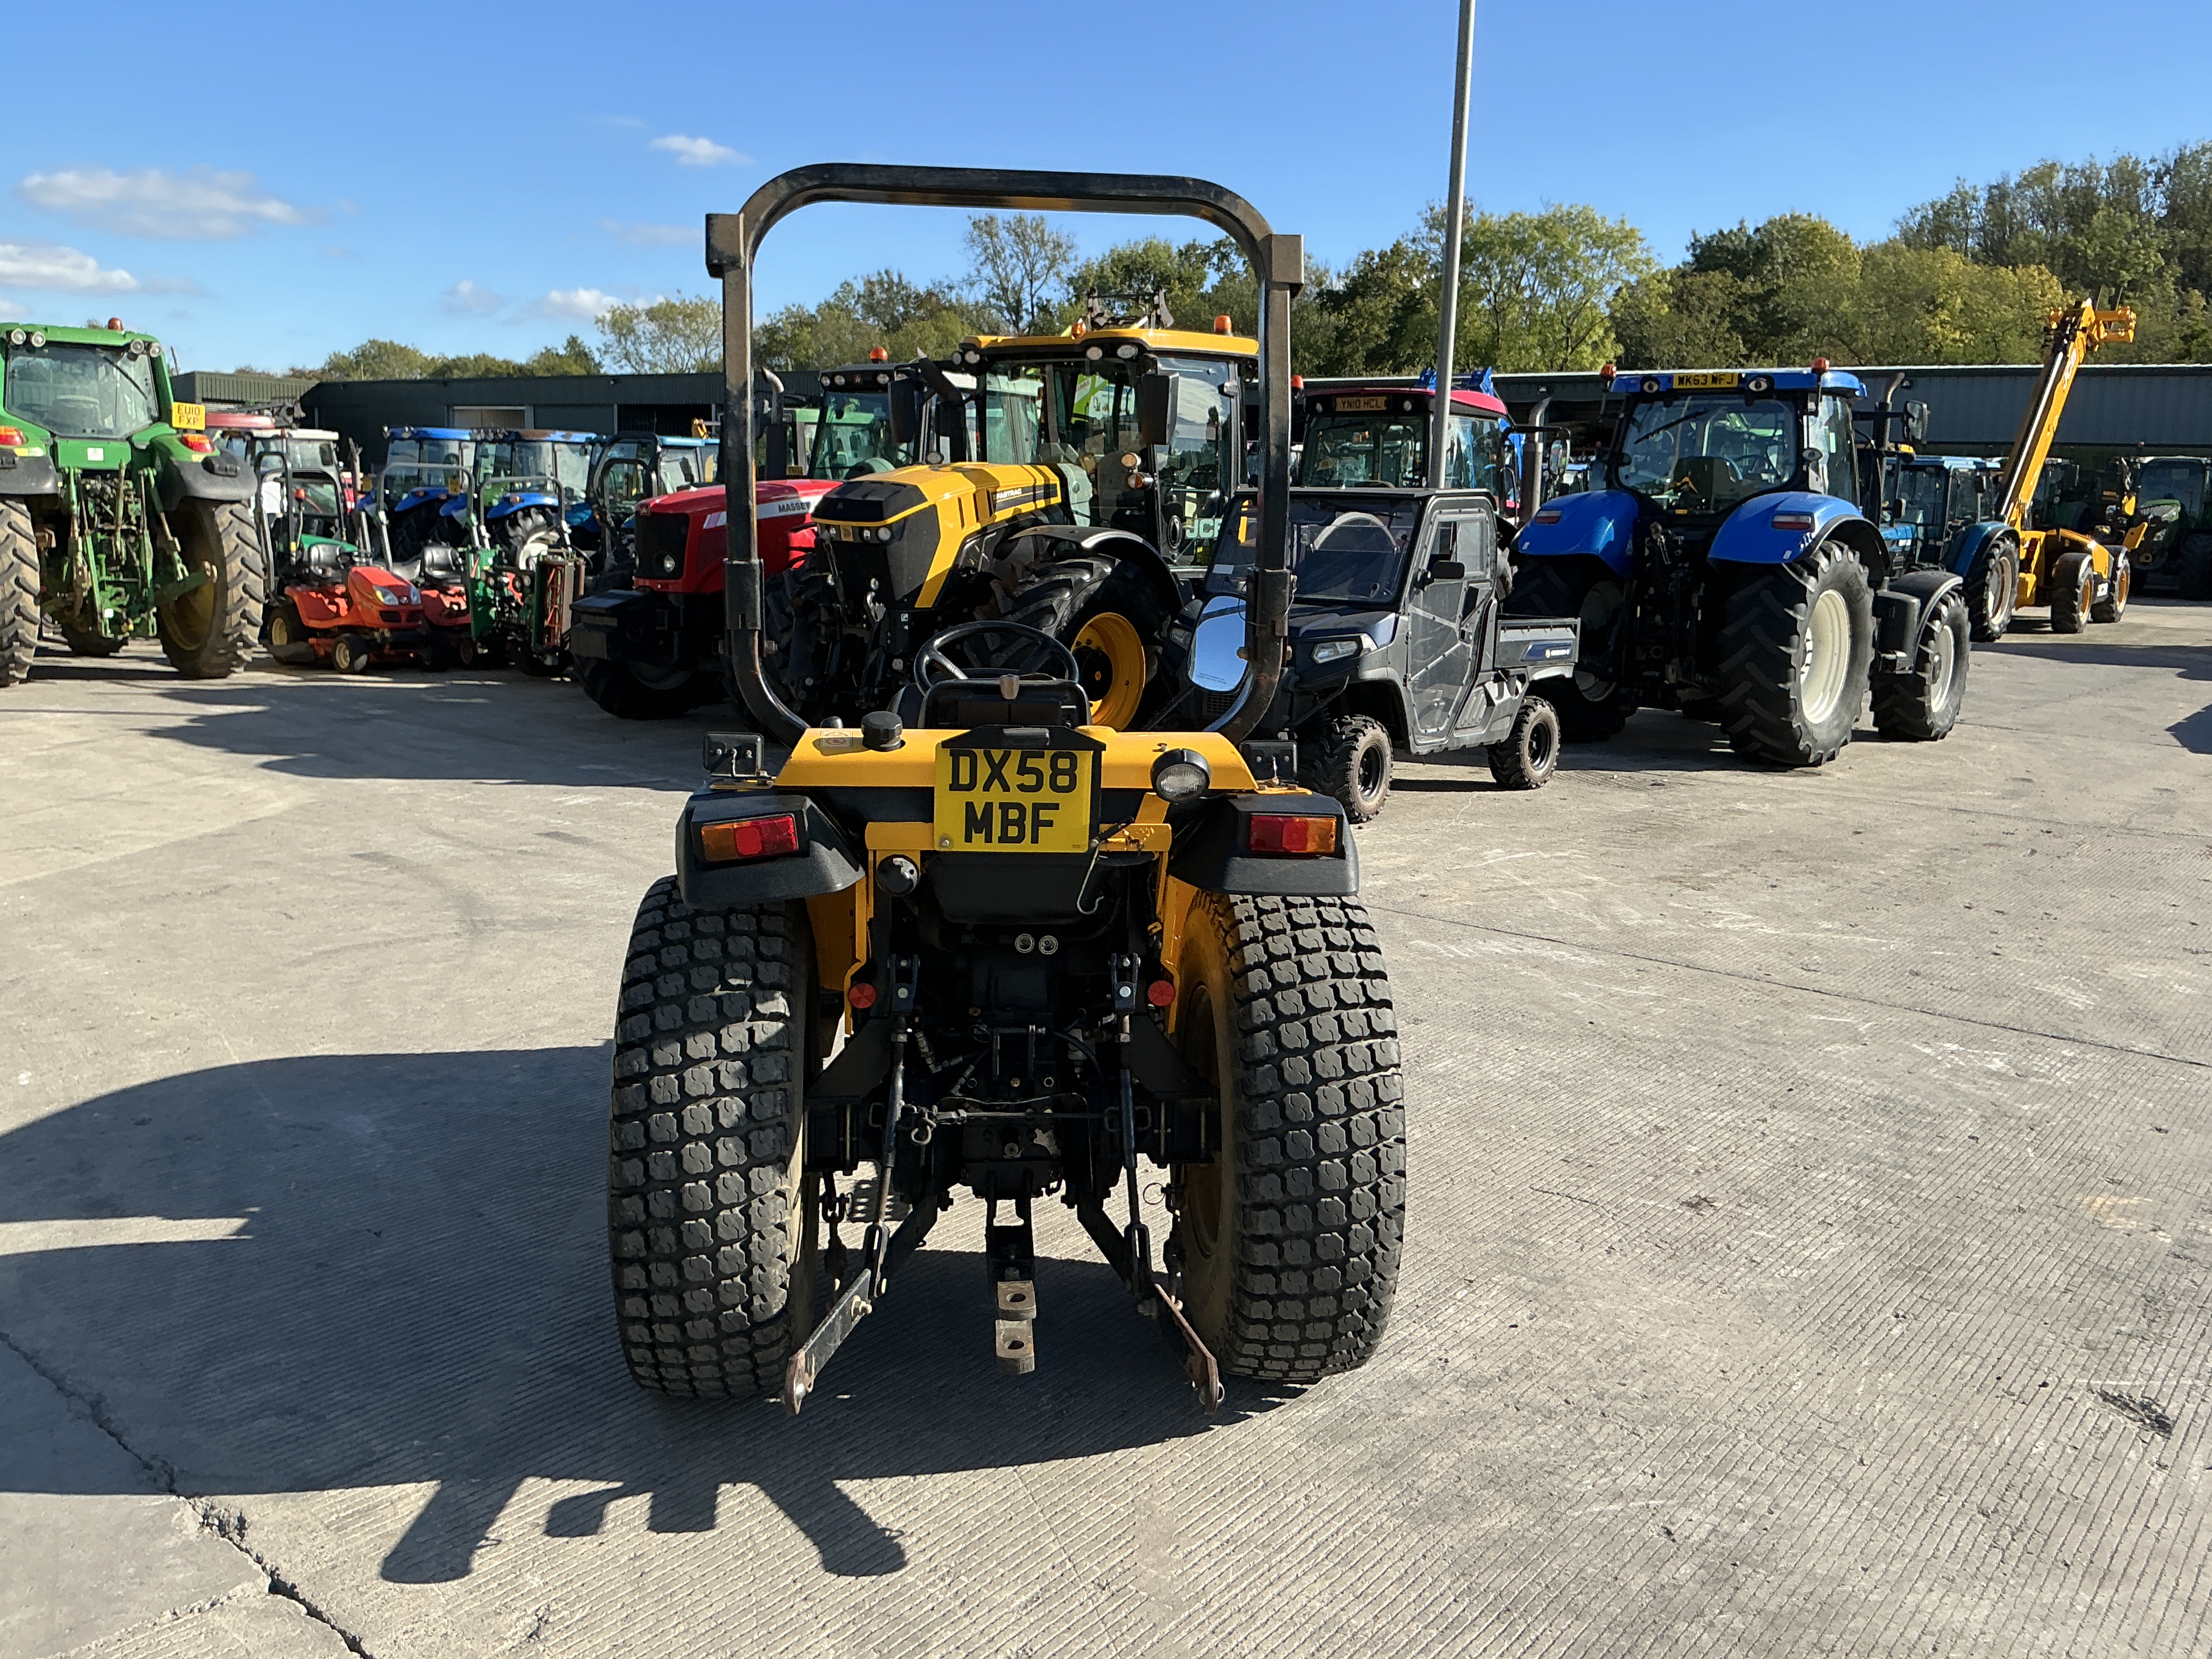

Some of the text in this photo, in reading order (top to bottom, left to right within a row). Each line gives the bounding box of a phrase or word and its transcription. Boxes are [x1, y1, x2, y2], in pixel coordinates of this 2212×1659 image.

[778, 501, 811, 513] MASSEY
[949, 749, 1077, 793] DX58
[964, 801, 1059, 844] MBF
